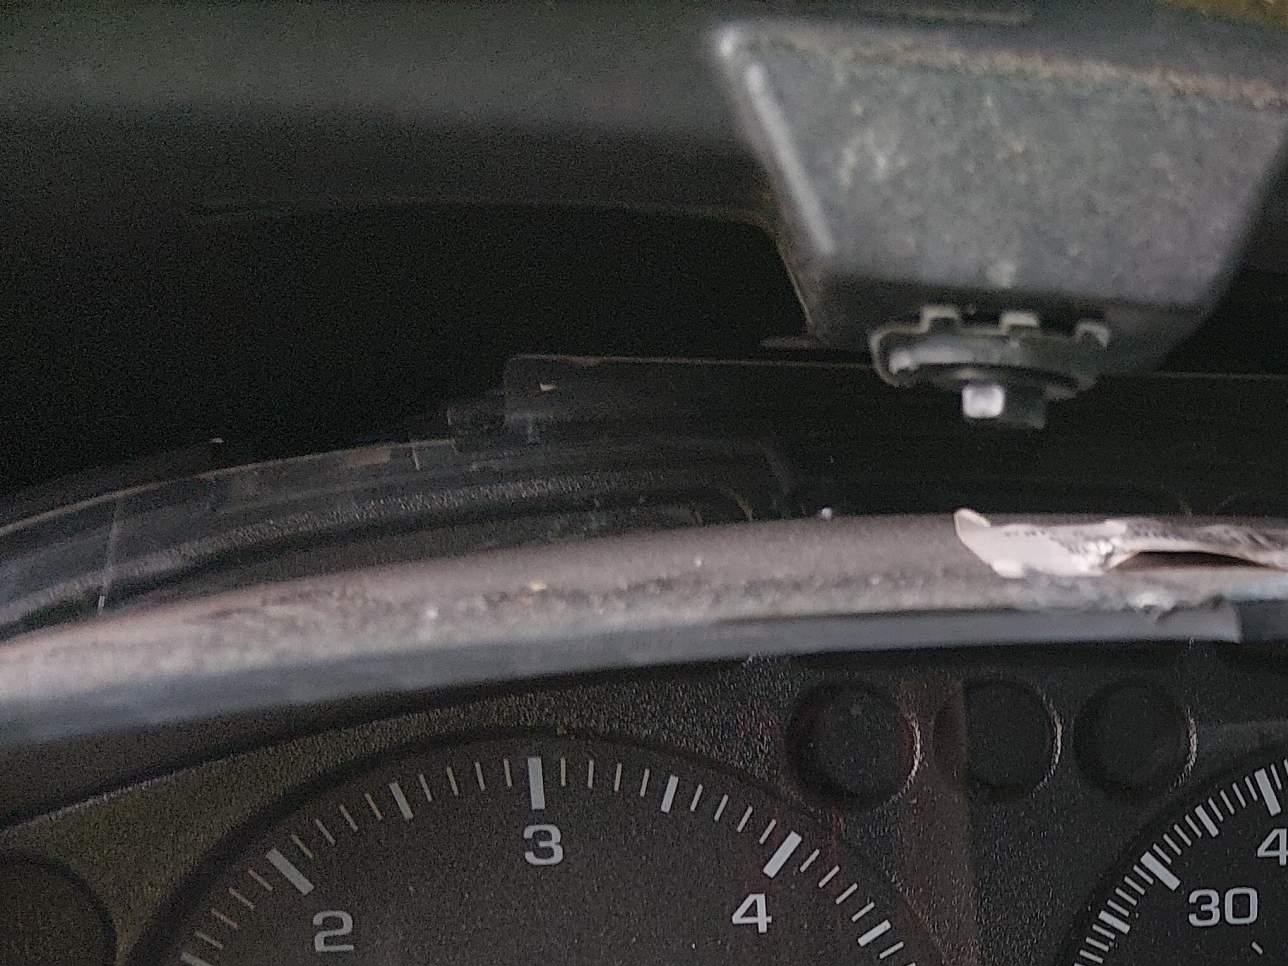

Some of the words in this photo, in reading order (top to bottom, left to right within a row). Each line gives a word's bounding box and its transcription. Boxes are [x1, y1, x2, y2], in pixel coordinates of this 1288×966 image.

[522, 822, 564, 866] 3
[731, 893, 773, 933] 4
[1187, 886, 1259, 927] 30
[311, 909, 355, 952] 2
